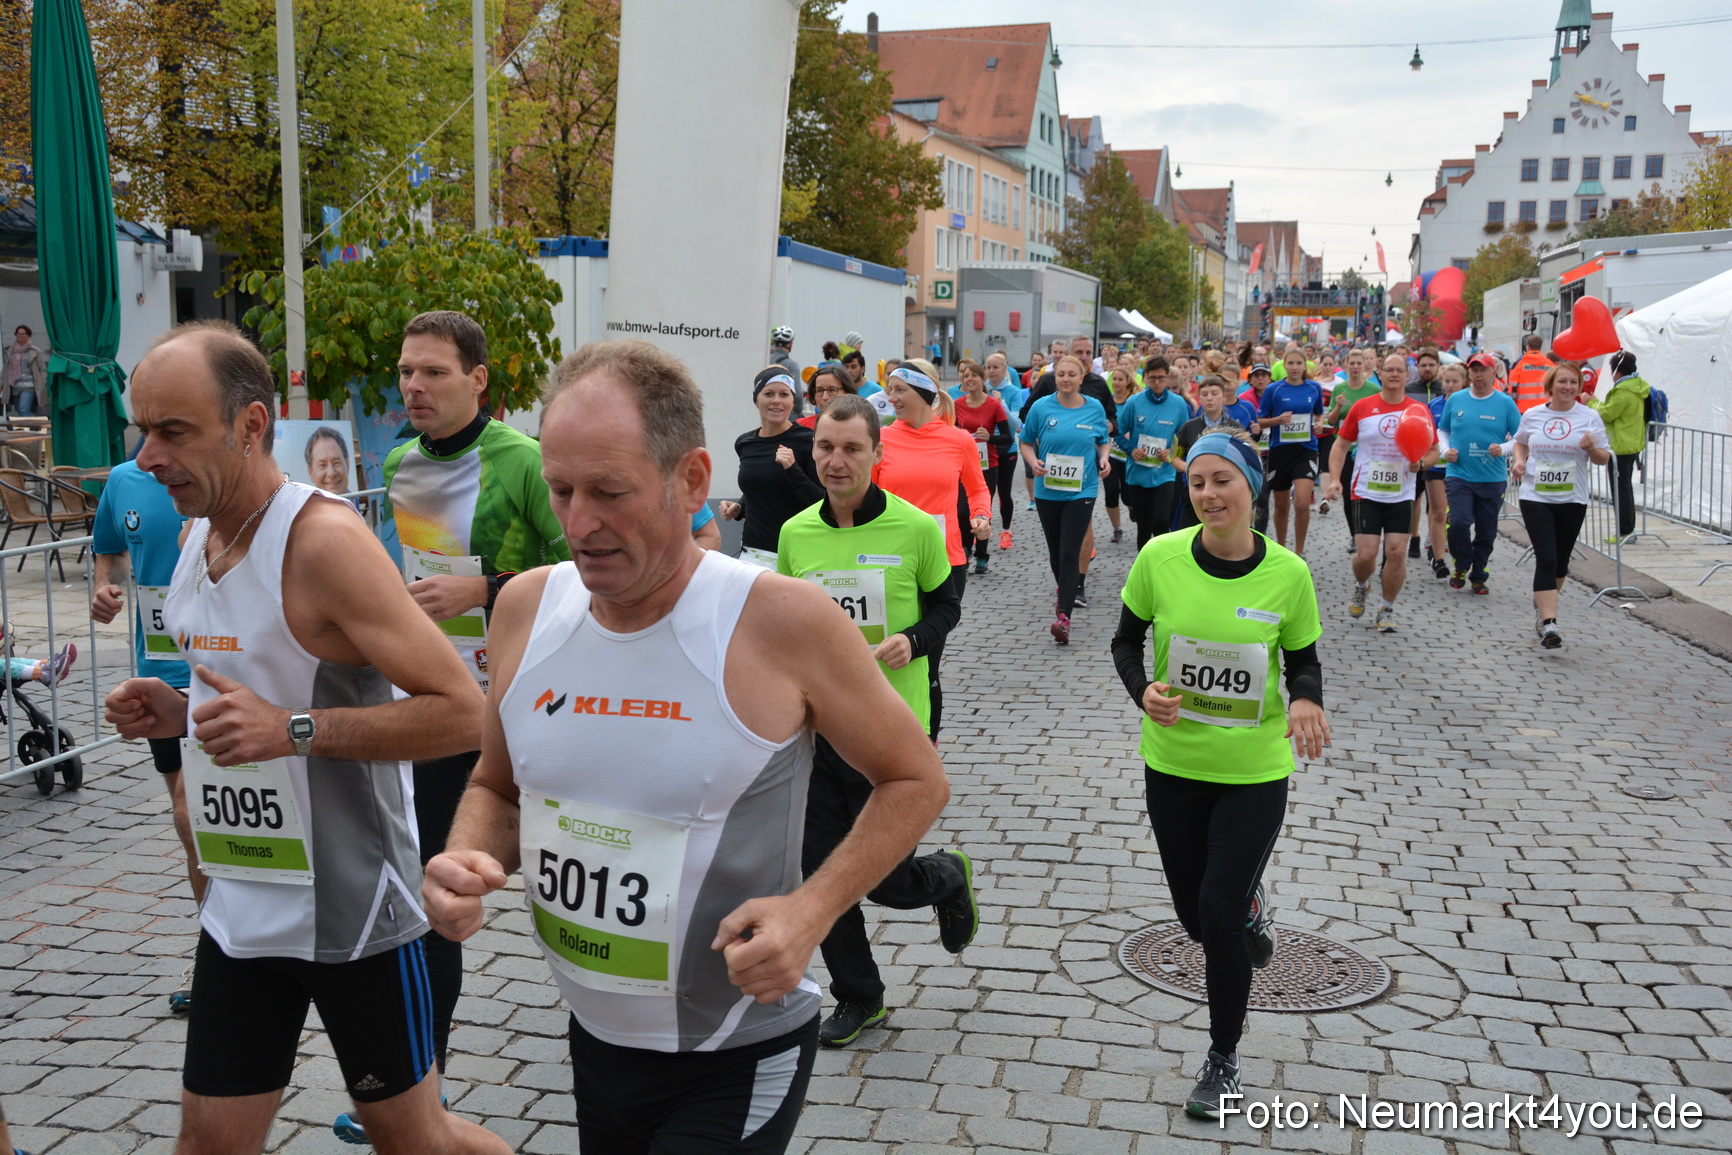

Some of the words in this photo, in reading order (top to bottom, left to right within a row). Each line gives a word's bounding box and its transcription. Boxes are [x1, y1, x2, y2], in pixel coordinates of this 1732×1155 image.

[937, 282, 951, 297] D
[606, 319, 740, 339] www.bmw-laufsport.de
[1050, 465, 1077, 477] 5147
[1372, 470, 1398, 483] 5158
[1540, 472, 1569, 482] 5047
[425, 560, 452, 573] BOCK
[829, 577, 858, 586] BOCK
[193, 635, 243, 651] KLEBL
[1205, 648, 1240, 659] BOCK
[1180, 663, 1251, 694] 5049
[573, 696, 692, 721] KLEBL
[1193, 696, 1232, 712] Stefanie
[202, 784, 283, 830] 5095
[571, 819, 632, 845] BOCK
[226, 841, 273, 858] Thomas
[538, 848, 649, 927] 5013
[559, 927, 610, 960] Roland
